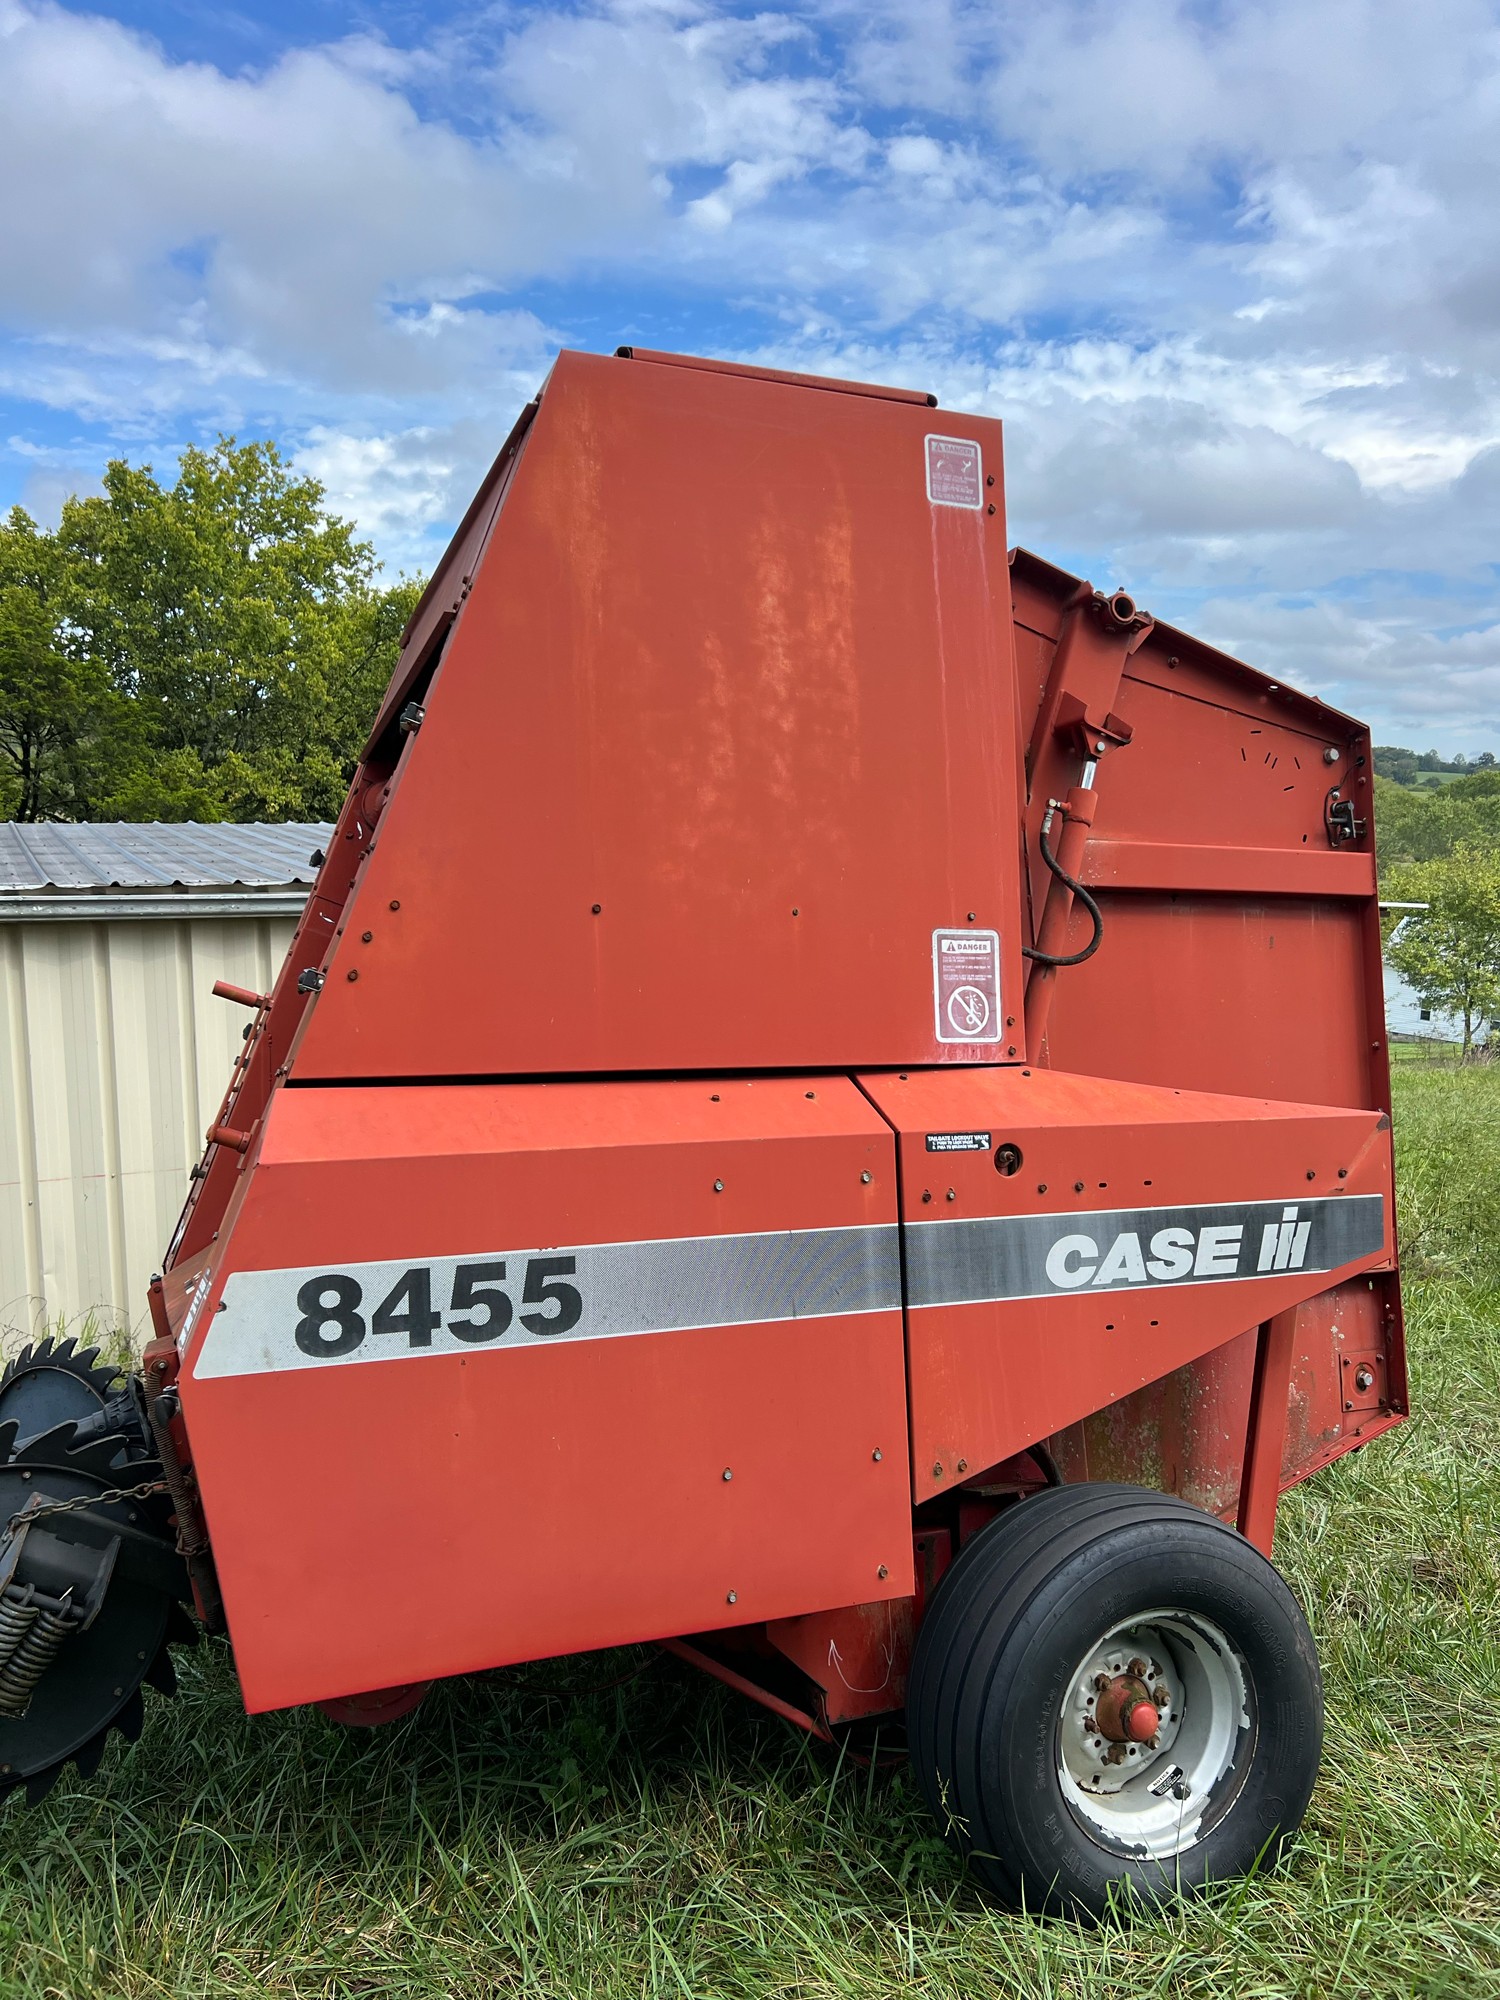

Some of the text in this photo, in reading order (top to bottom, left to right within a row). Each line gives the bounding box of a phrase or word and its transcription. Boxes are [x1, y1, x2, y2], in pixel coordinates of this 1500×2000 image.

[944, 445, 972, 455] DANGER
[957, 943, 988, 951] DANGER
[1046, 1225, 1243, 1288] CASE
[295, 1256, 582, 1358] 8455
[1152, 1771, 1170, 1787] NOTICE
